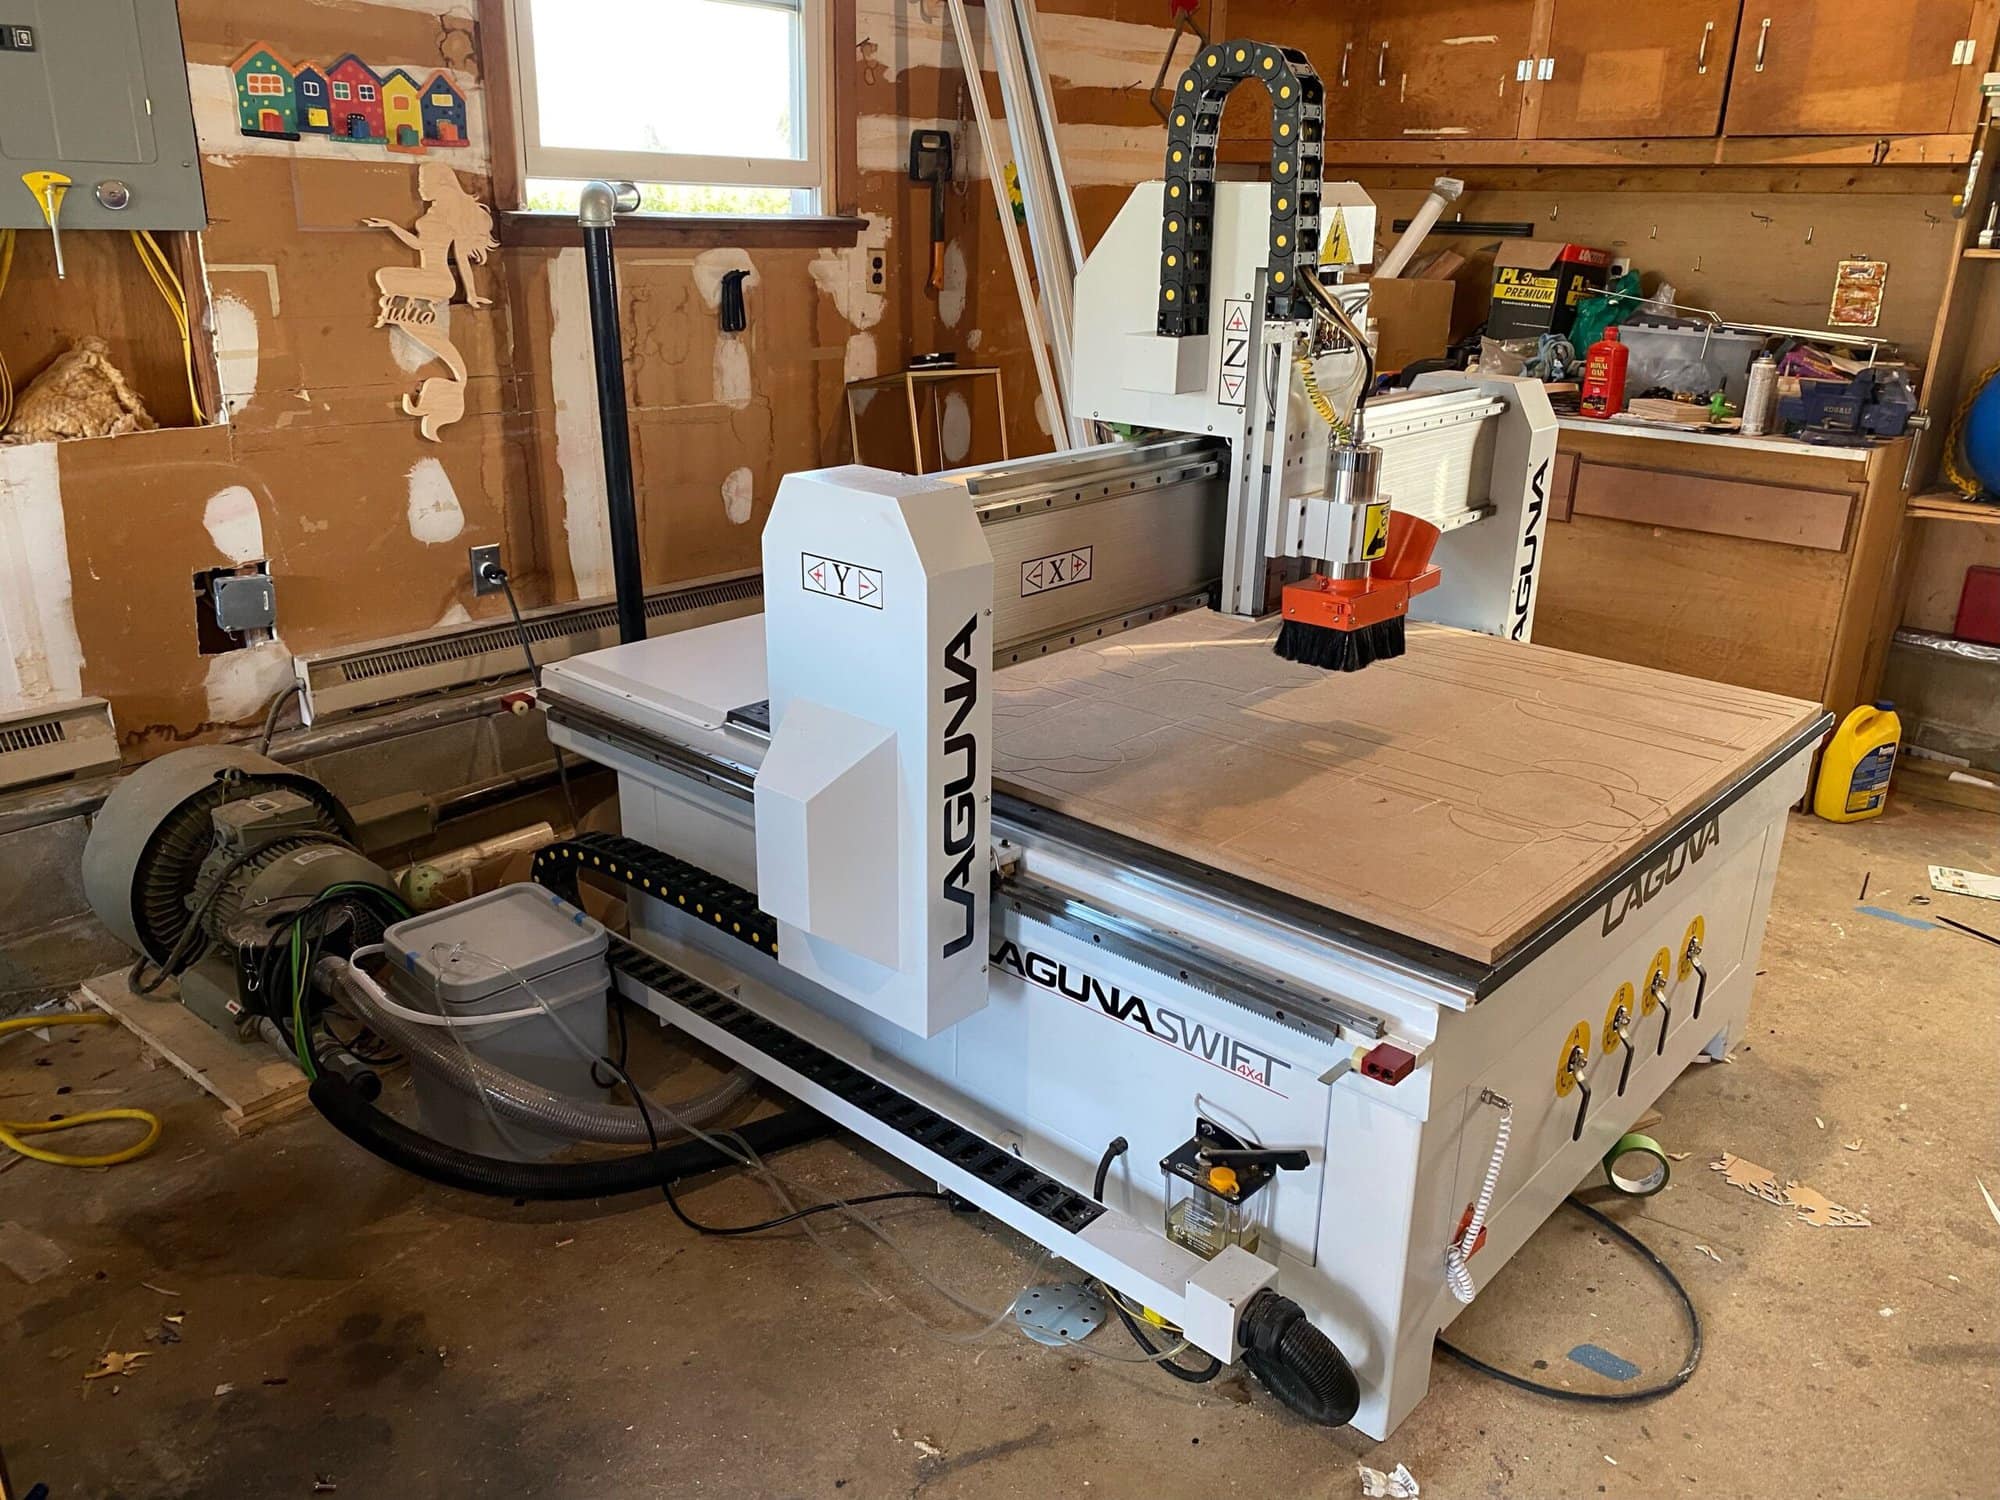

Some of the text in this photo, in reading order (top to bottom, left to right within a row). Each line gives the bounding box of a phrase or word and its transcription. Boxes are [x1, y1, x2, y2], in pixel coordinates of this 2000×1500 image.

[1500, 268, 1520, 285] PL
[1504, 287, 1553, 301] PREMIUM
[1224, 338, 1248, 368] Z
[1512, 457, 1549, 641] AGUNA
[832, 564, 852, 596] Y
[1048, 559, 1066, 584] X
[943, 613, 978, 959] LAGUNA
[1602, 815, 1720, 938] LAGUNA
